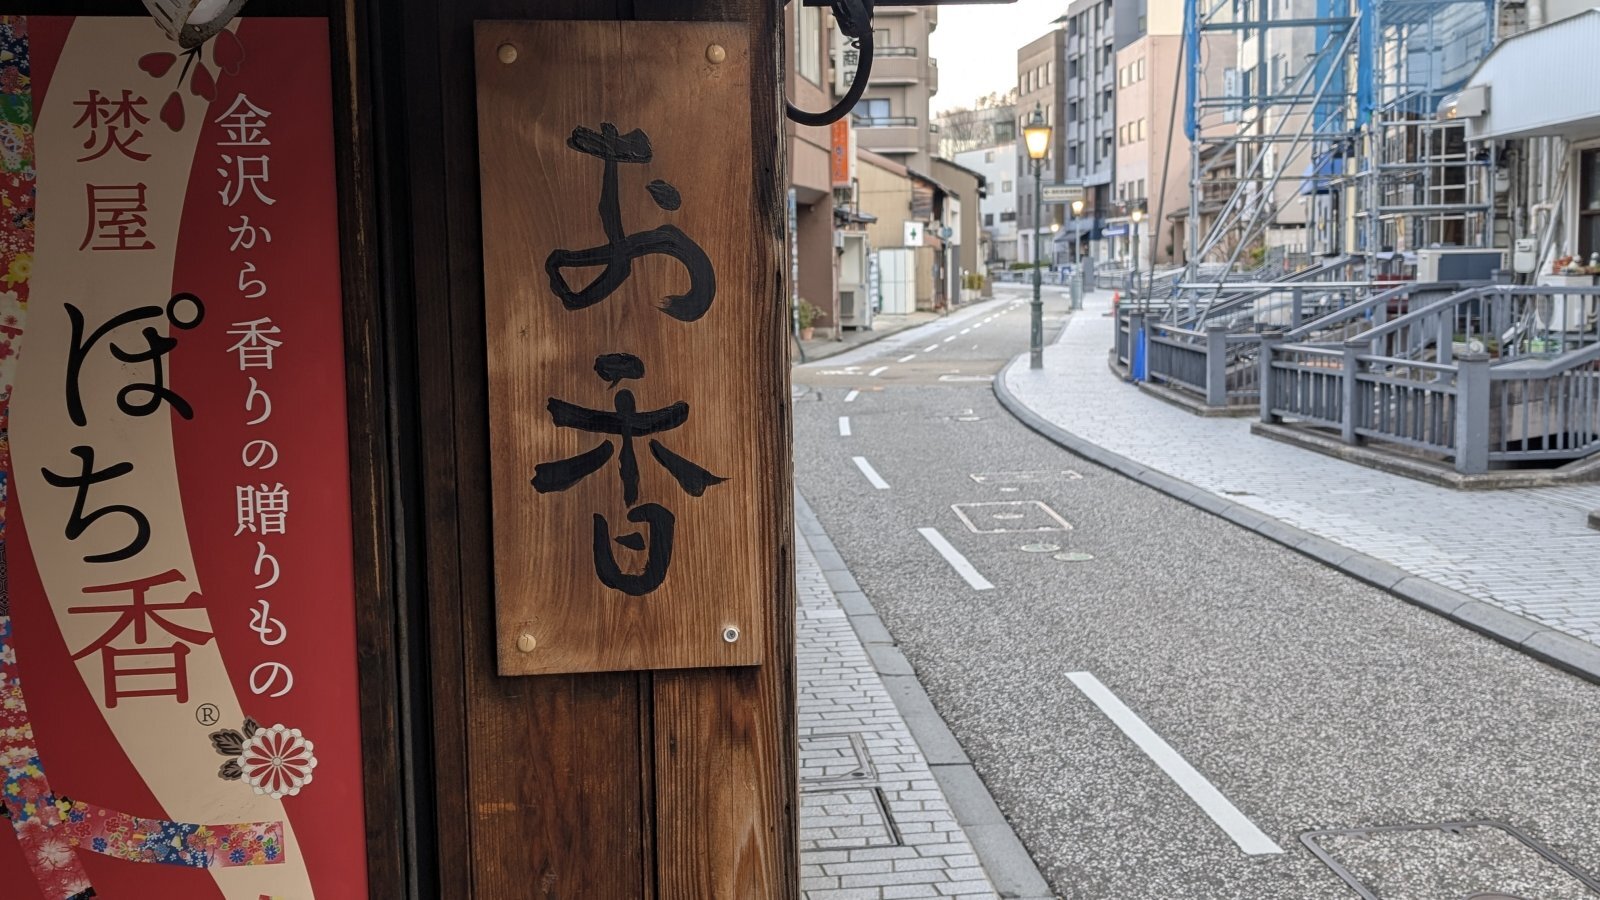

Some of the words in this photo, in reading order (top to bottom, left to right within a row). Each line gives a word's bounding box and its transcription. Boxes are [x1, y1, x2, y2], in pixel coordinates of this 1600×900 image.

[72, 89, 156, 251] 焚屋
[531, 121, 732, 597] お香
[41, 293, 215, 708] ぽち香
[214, 93, 294, 697] 金沢から香りの贈りもの
